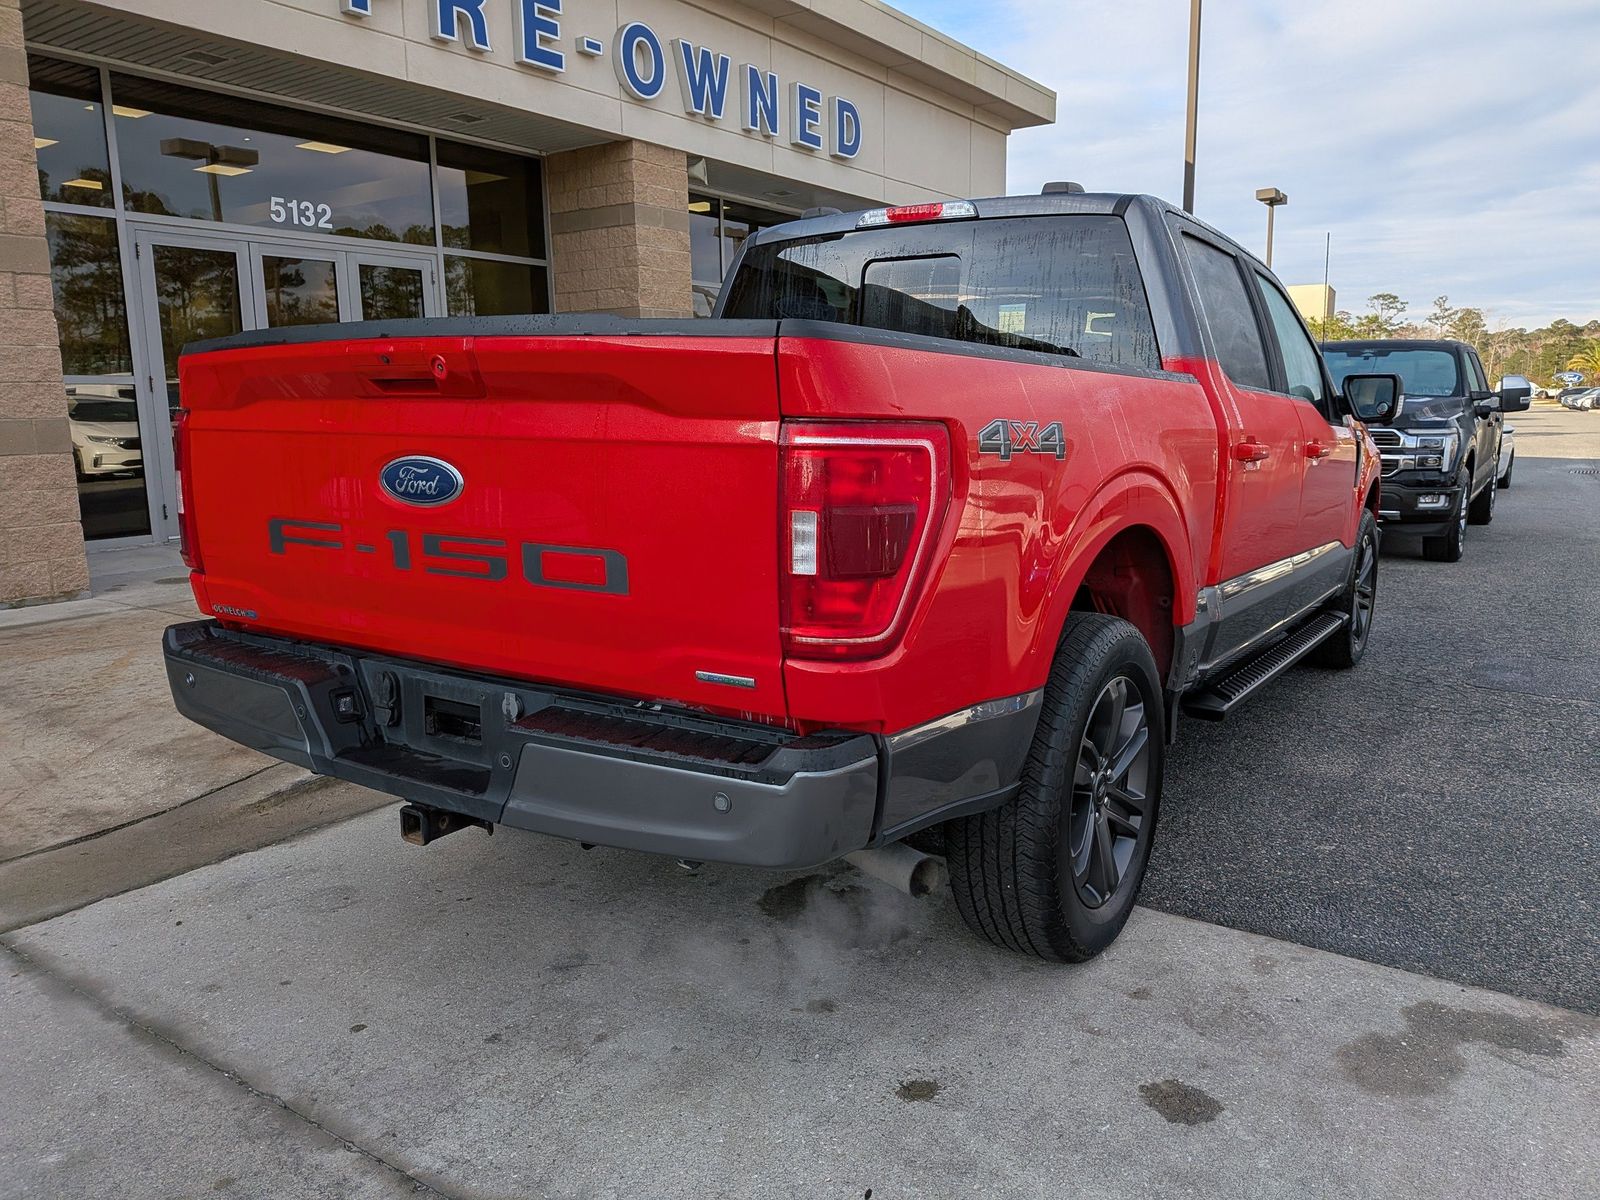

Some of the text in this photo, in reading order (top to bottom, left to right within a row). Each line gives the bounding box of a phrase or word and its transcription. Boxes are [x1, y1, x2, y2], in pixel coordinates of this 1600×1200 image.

[341, 0, 862, 160] RE-OWNED
[270, 196, 333, 229] 5132
[396, 465, 440, 495] Ford
[268, 517, 630, 596] F-150
